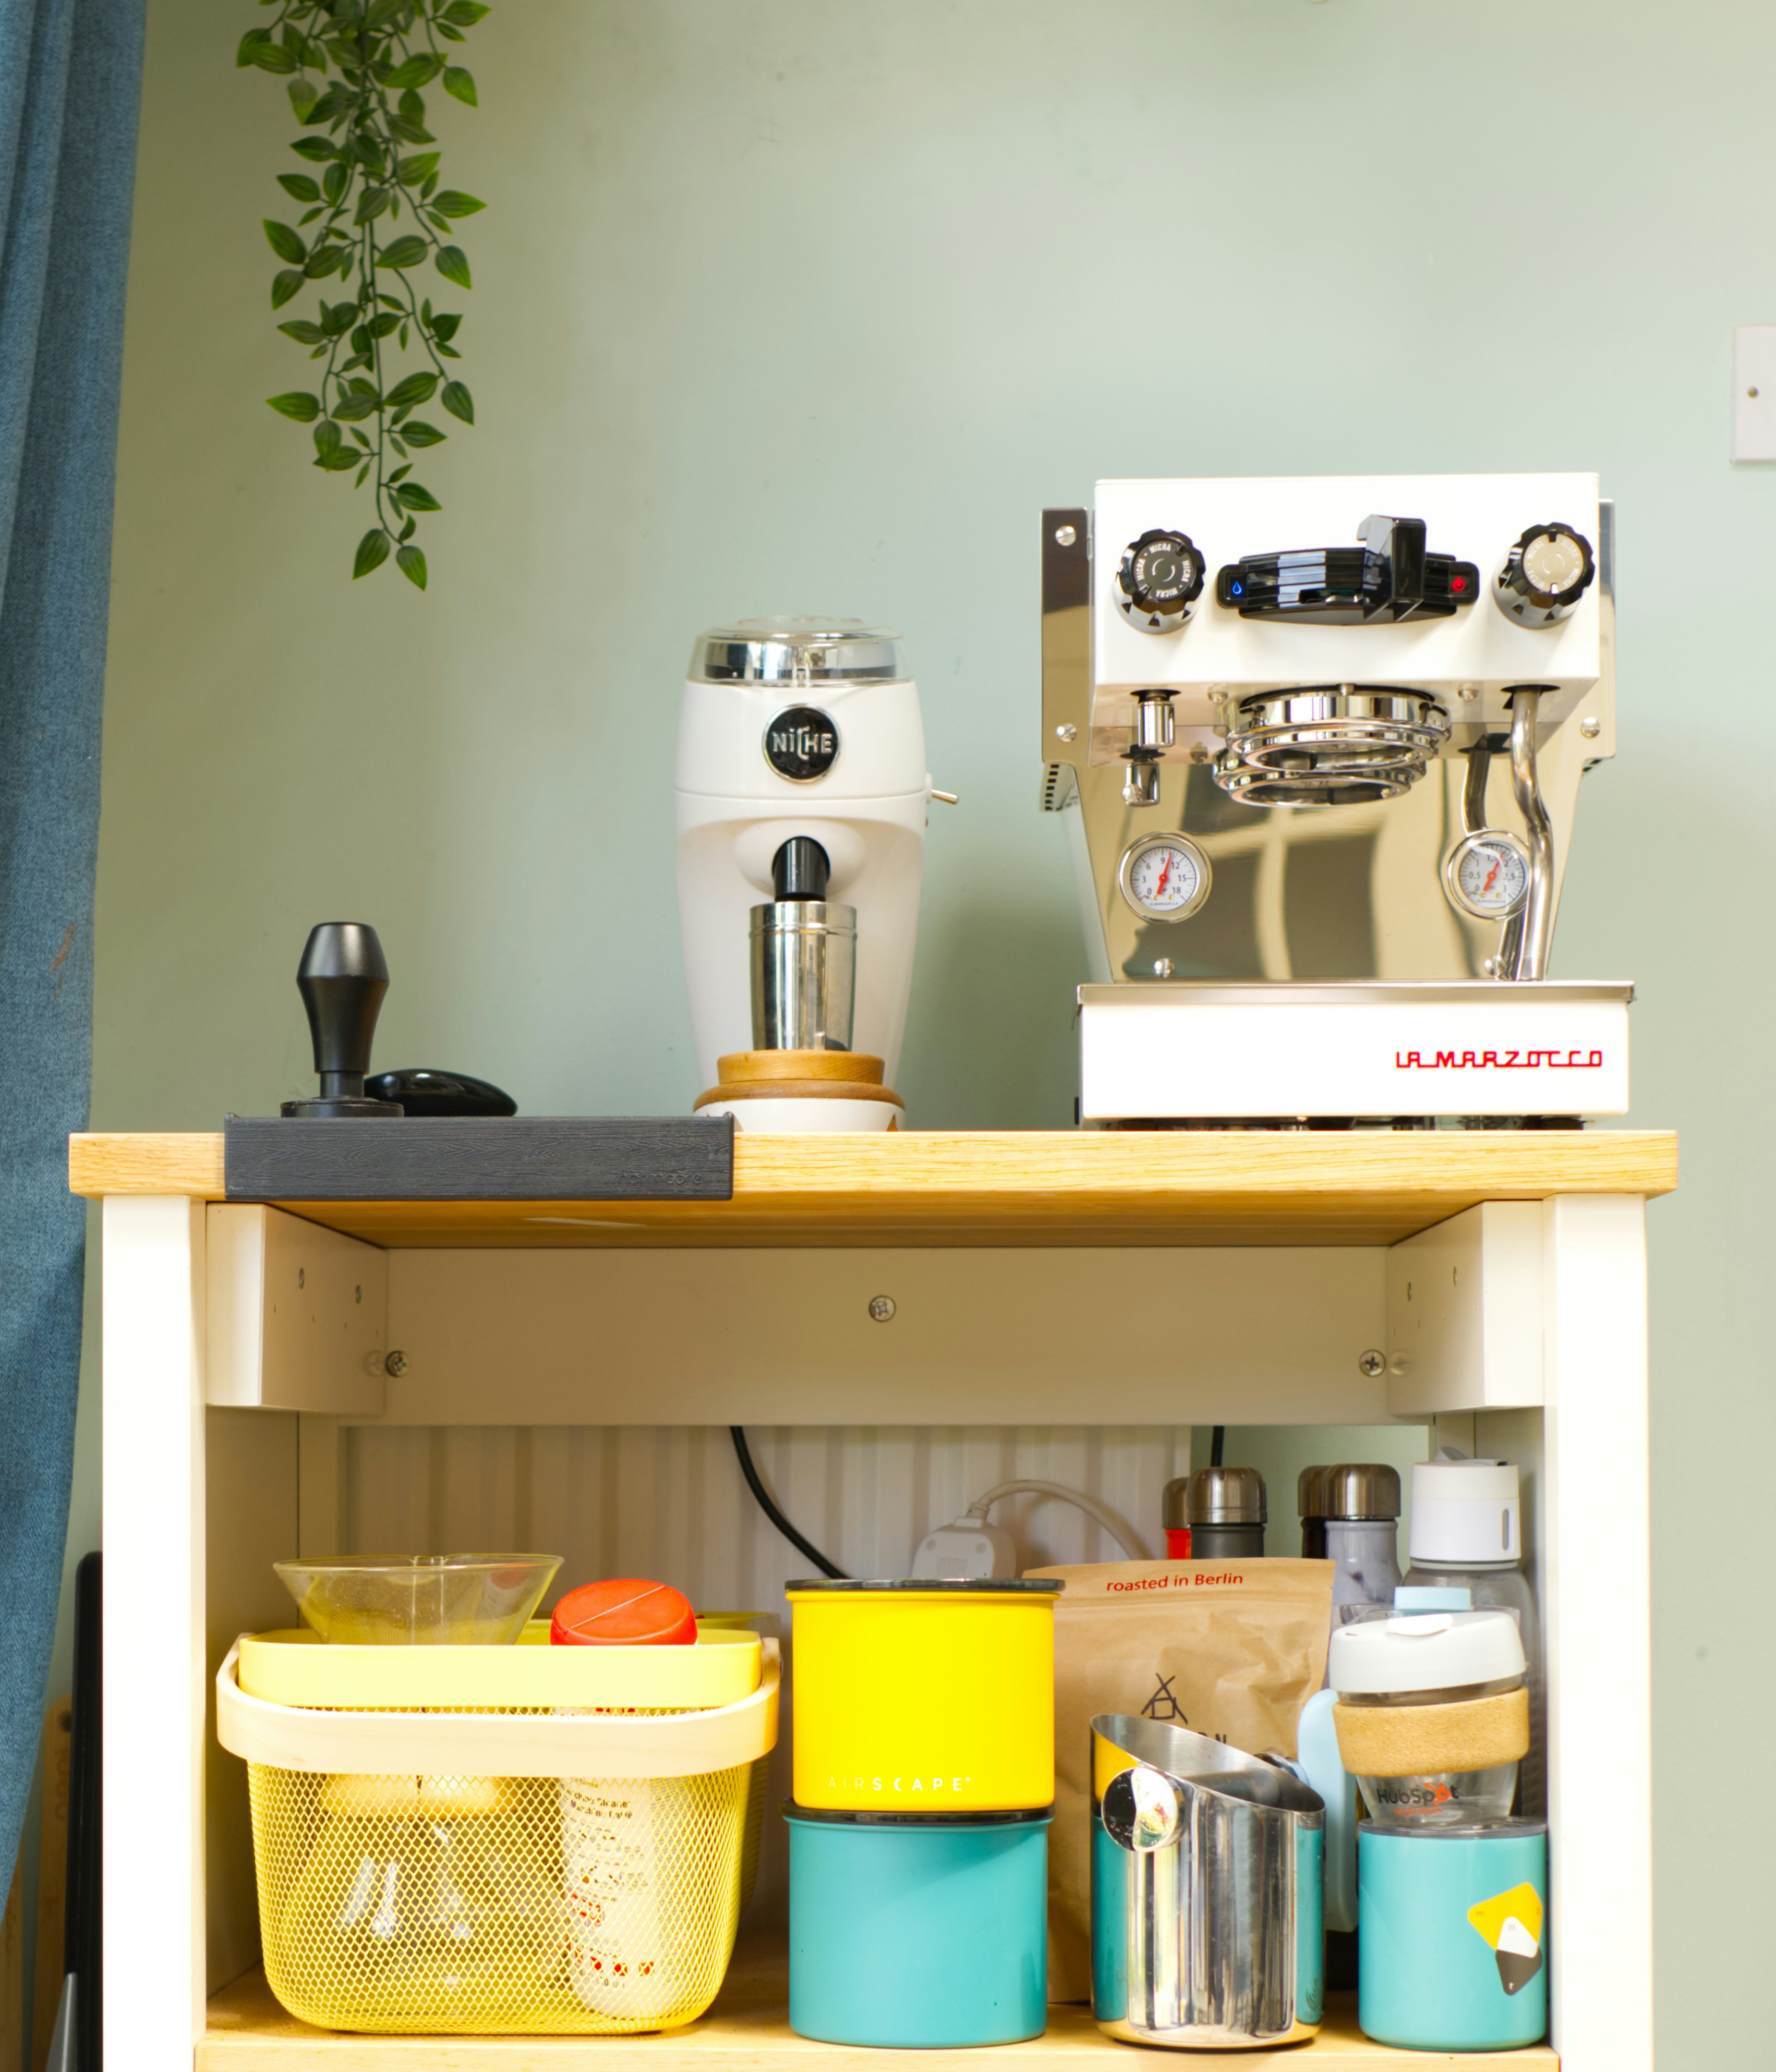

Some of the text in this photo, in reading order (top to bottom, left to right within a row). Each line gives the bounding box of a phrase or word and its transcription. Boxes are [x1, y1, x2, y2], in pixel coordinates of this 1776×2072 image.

[1149, 543, 1171, 553] MICRA
[1136, 558, 1146, 581] MICRA
[1181, 560, 1191, 582] MICRA
[1156, 587, 1178, 598] MICRA
[1469, 871, 1480, 880] 0,5
[1396, 1051, 1602, 1068] LA MARZOCCO
[1107, 1573, 1243, 1591] roasted in Berlin
[1376, 1782, 1459, 1806] HubSpot
